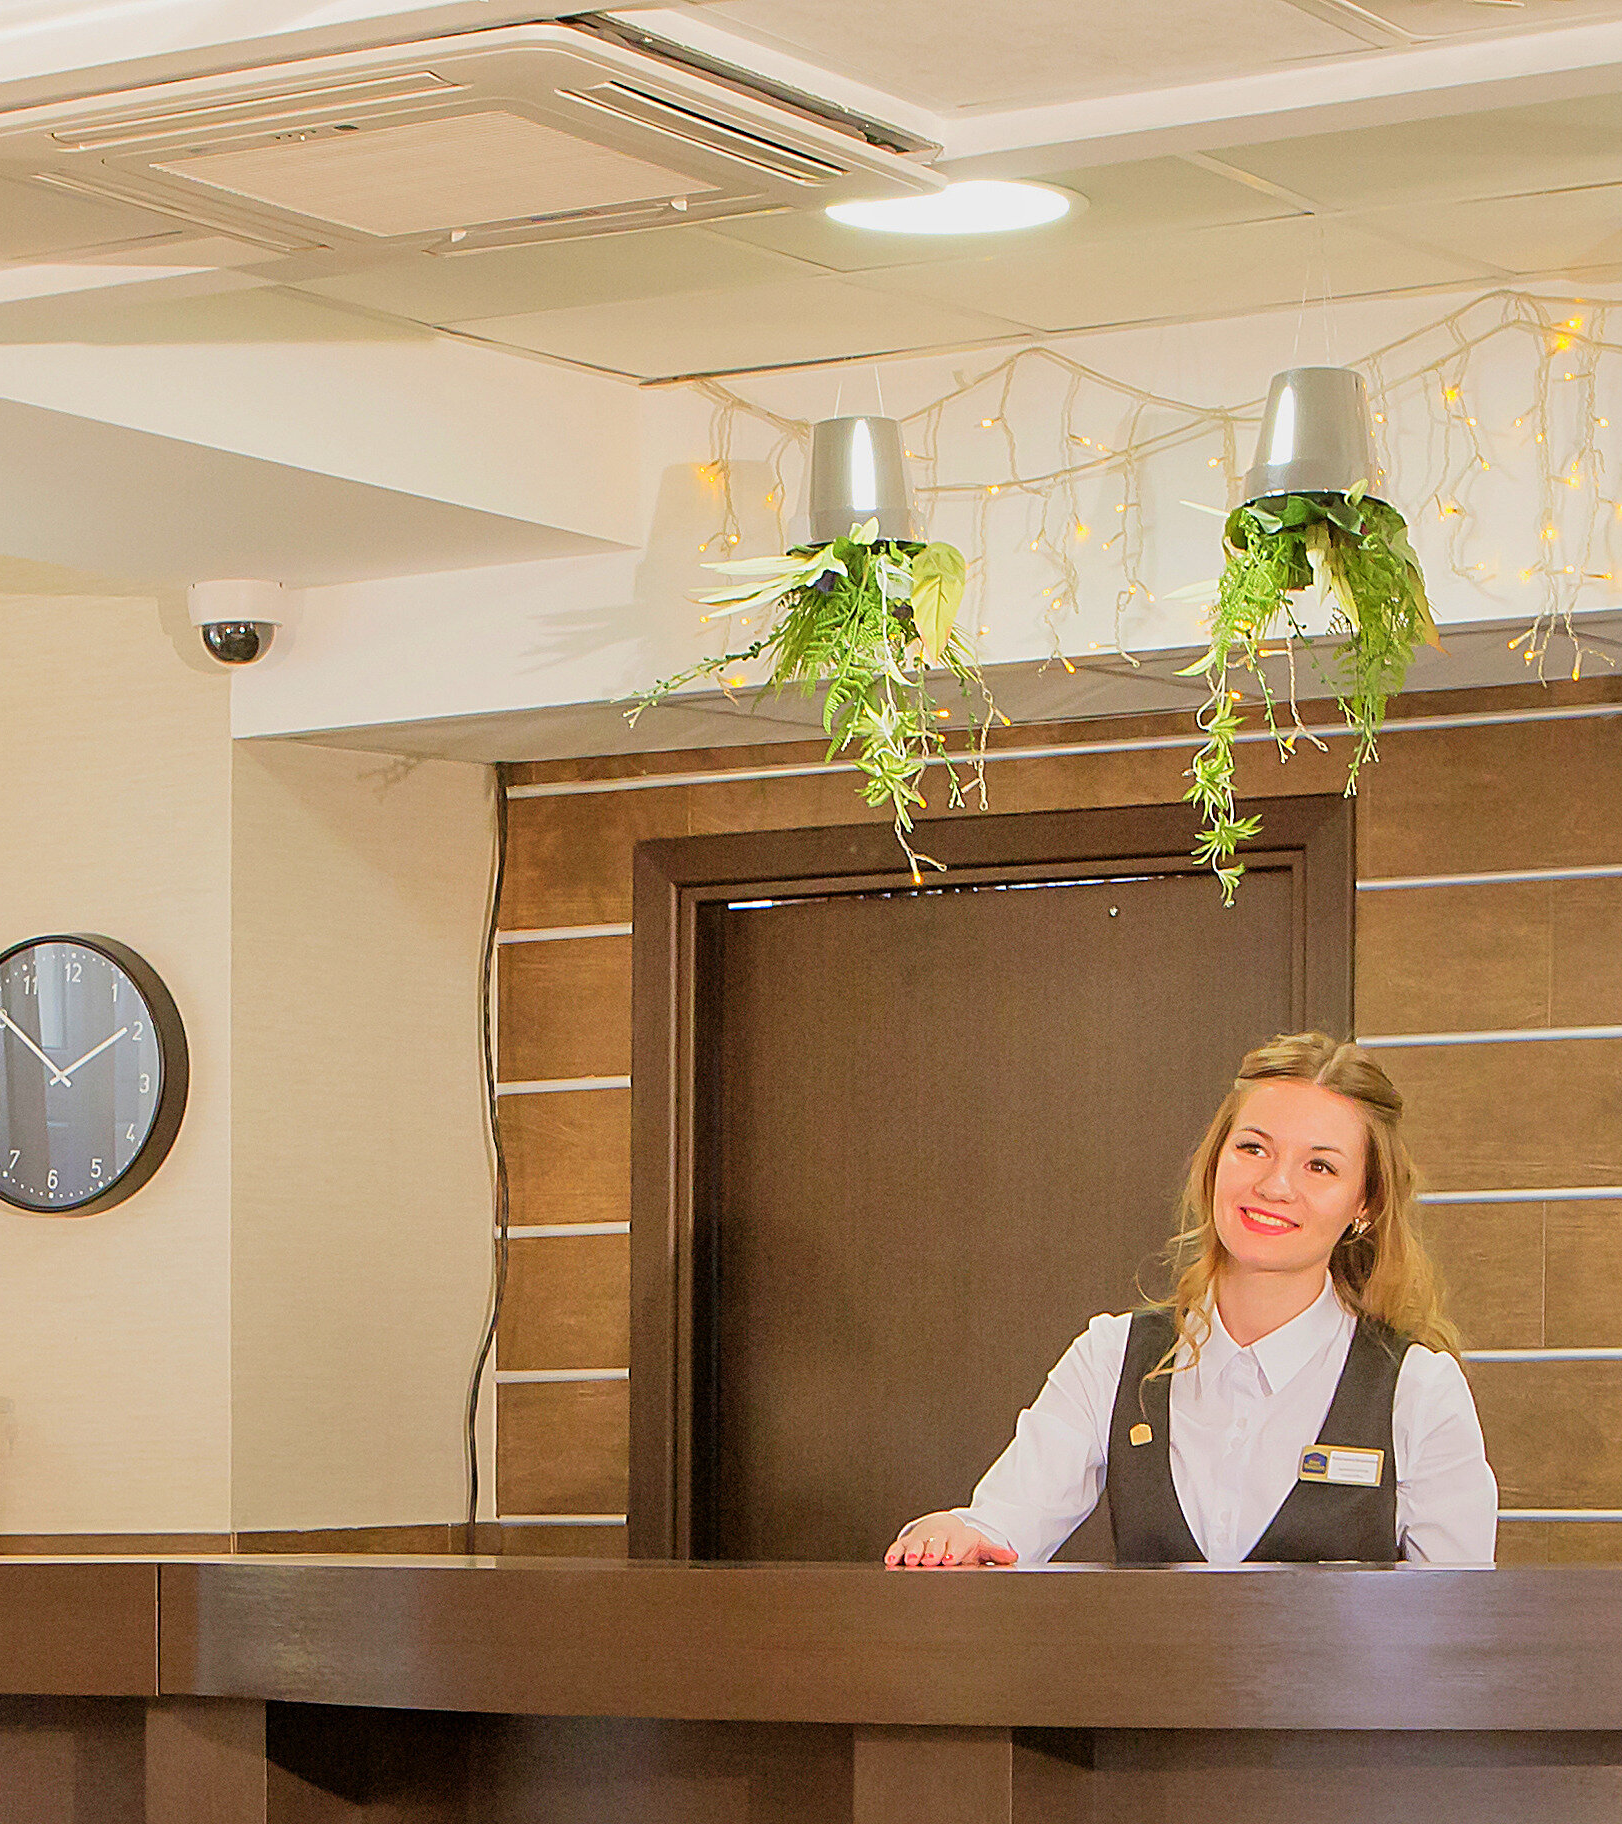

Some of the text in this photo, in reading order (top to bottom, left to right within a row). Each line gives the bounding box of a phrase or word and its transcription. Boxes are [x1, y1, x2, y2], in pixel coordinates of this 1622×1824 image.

[64, 962, 82, 984] 12
[22, 974, 39, 996] 11
[111, 982, 119, 1003] 1
[131, 1021, 144, 1042] 2
[139, 1073, 151, 1094] 3
[125, 1123, 136, 1143] 4
[9, 1149, 21, 1170] 7
[90, 1158, 103, 1179] 5
[47, 1169, 59, 1190] 6
